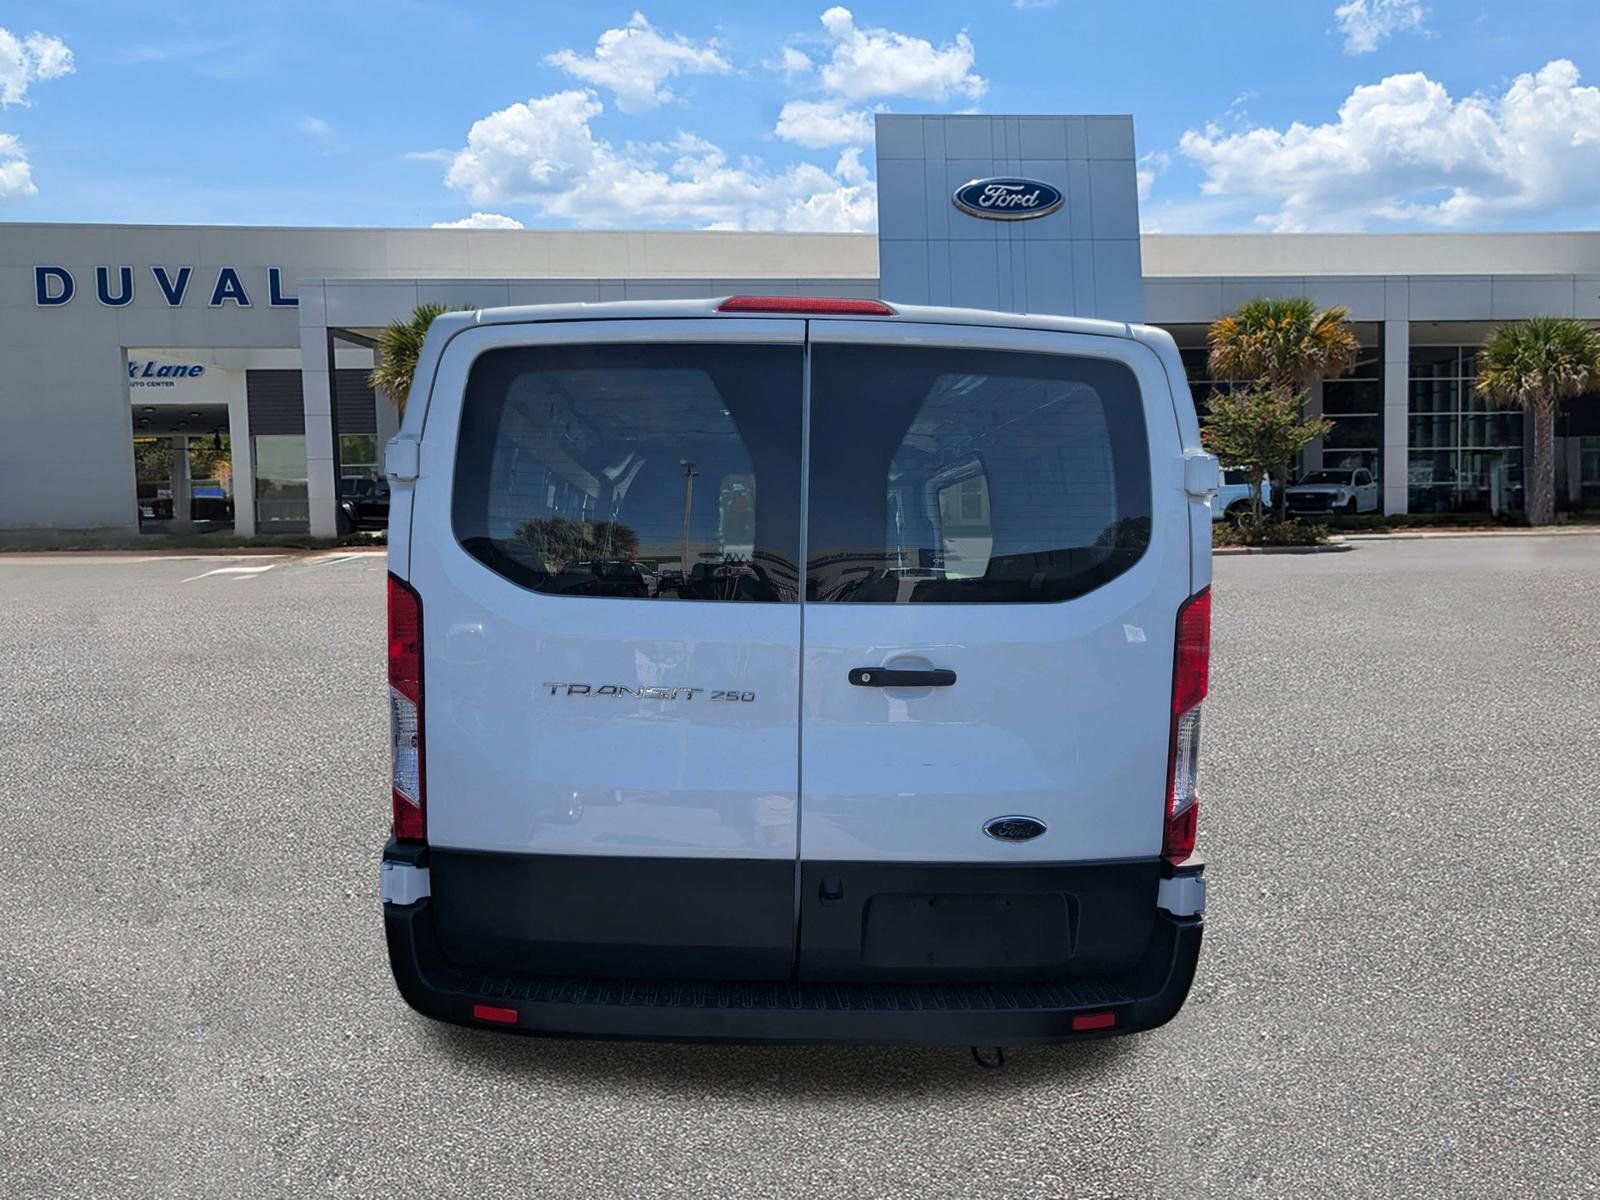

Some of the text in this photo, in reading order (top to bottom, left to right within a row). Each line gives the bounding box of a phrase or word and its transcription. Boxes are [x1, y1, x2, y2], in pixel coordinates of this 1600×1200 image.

[979, 185, 1041, 207] Ford
[34, 266, 299, 307] DUVAL
[141, 361, 204, 378] Lane
[129, 380, 176, 389] UTO CENTER
[542, 682, 756, 703] TRANSIT 250
